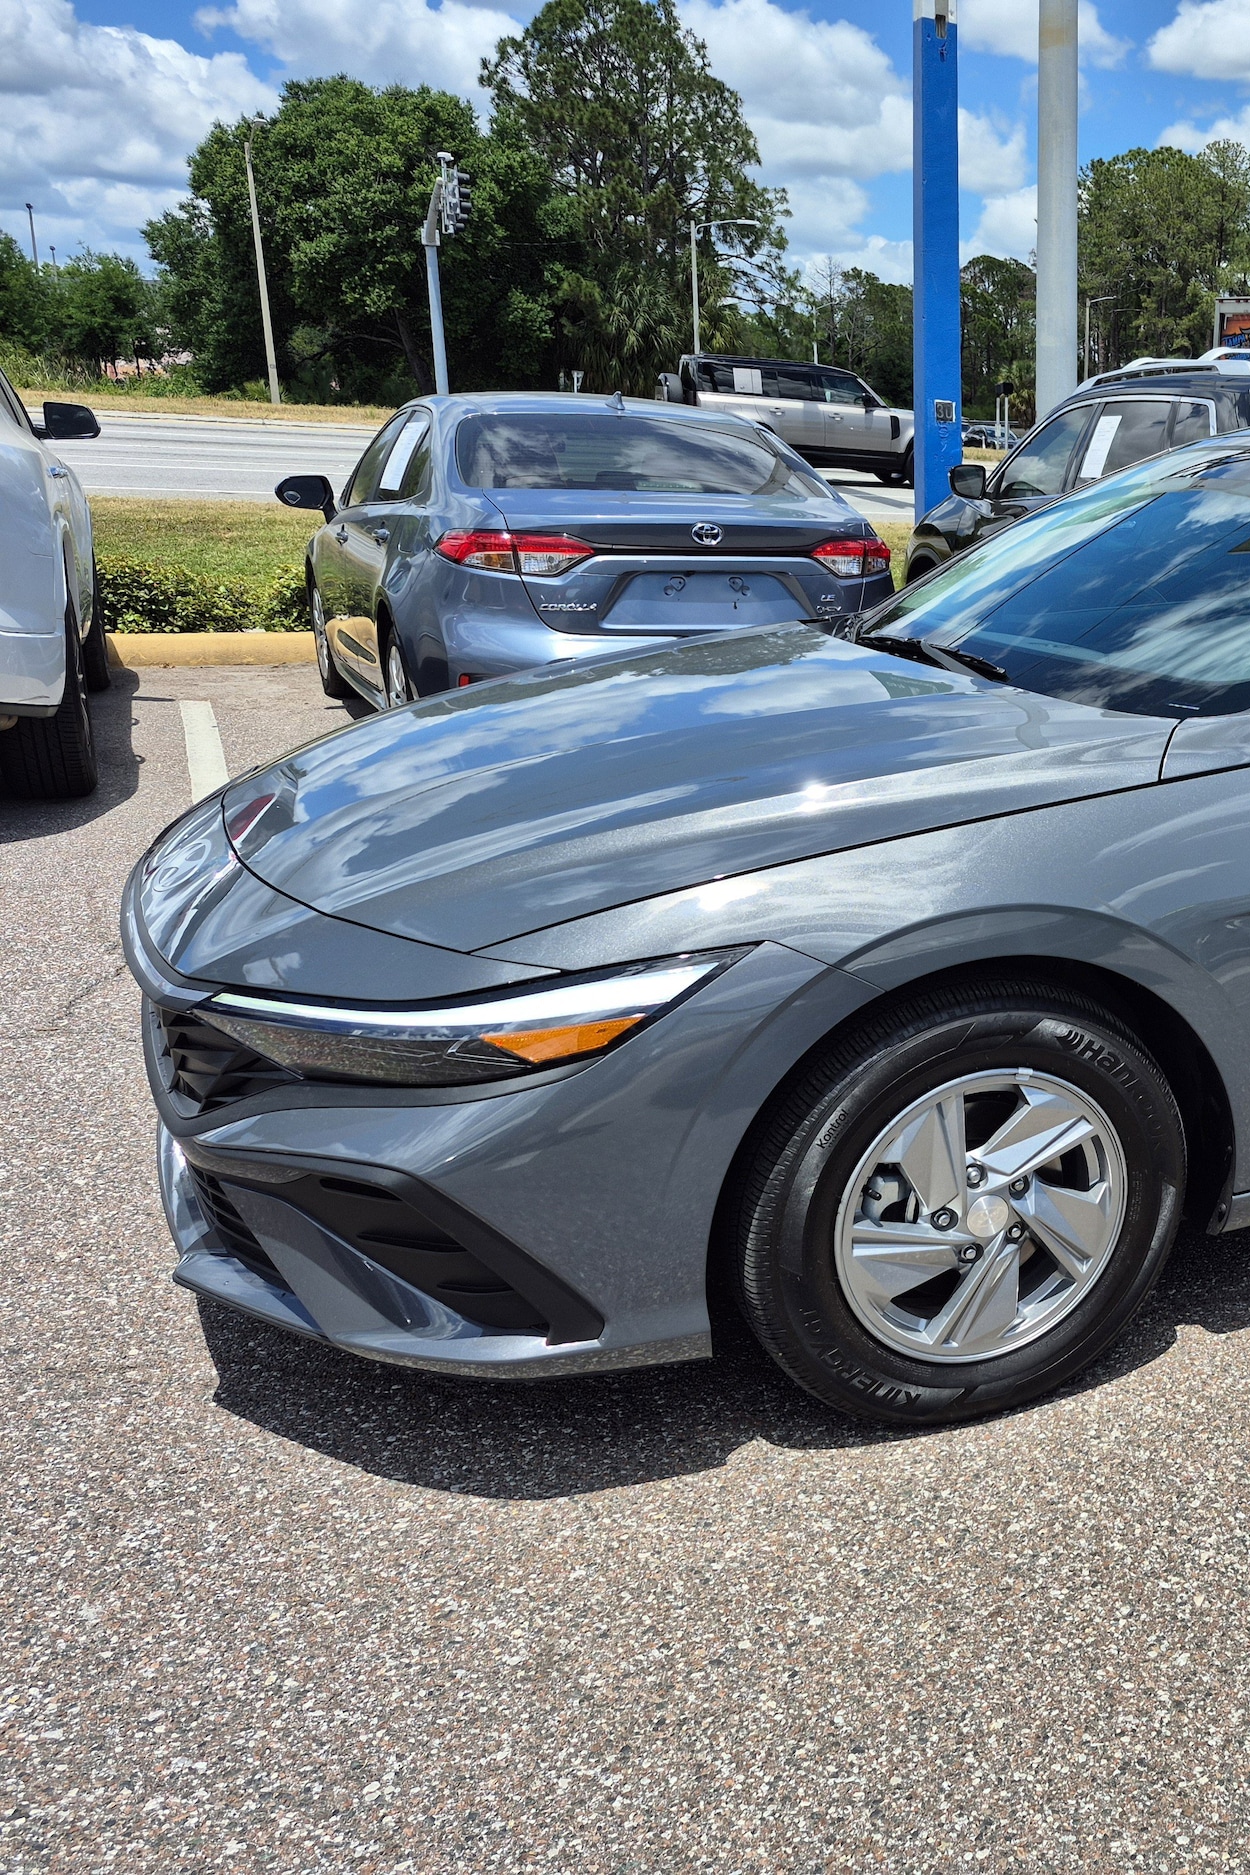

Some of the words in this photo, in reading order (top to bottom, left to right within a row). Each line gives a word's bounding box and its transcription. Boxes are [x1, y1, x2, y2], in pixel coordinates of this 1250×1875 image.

[936, 403, 953, 419] 30
[820, 594, 836, 602] LE
[539, 602, 597, 611] COROLLA
[816, 1108, 849, 1149] Kontrol
